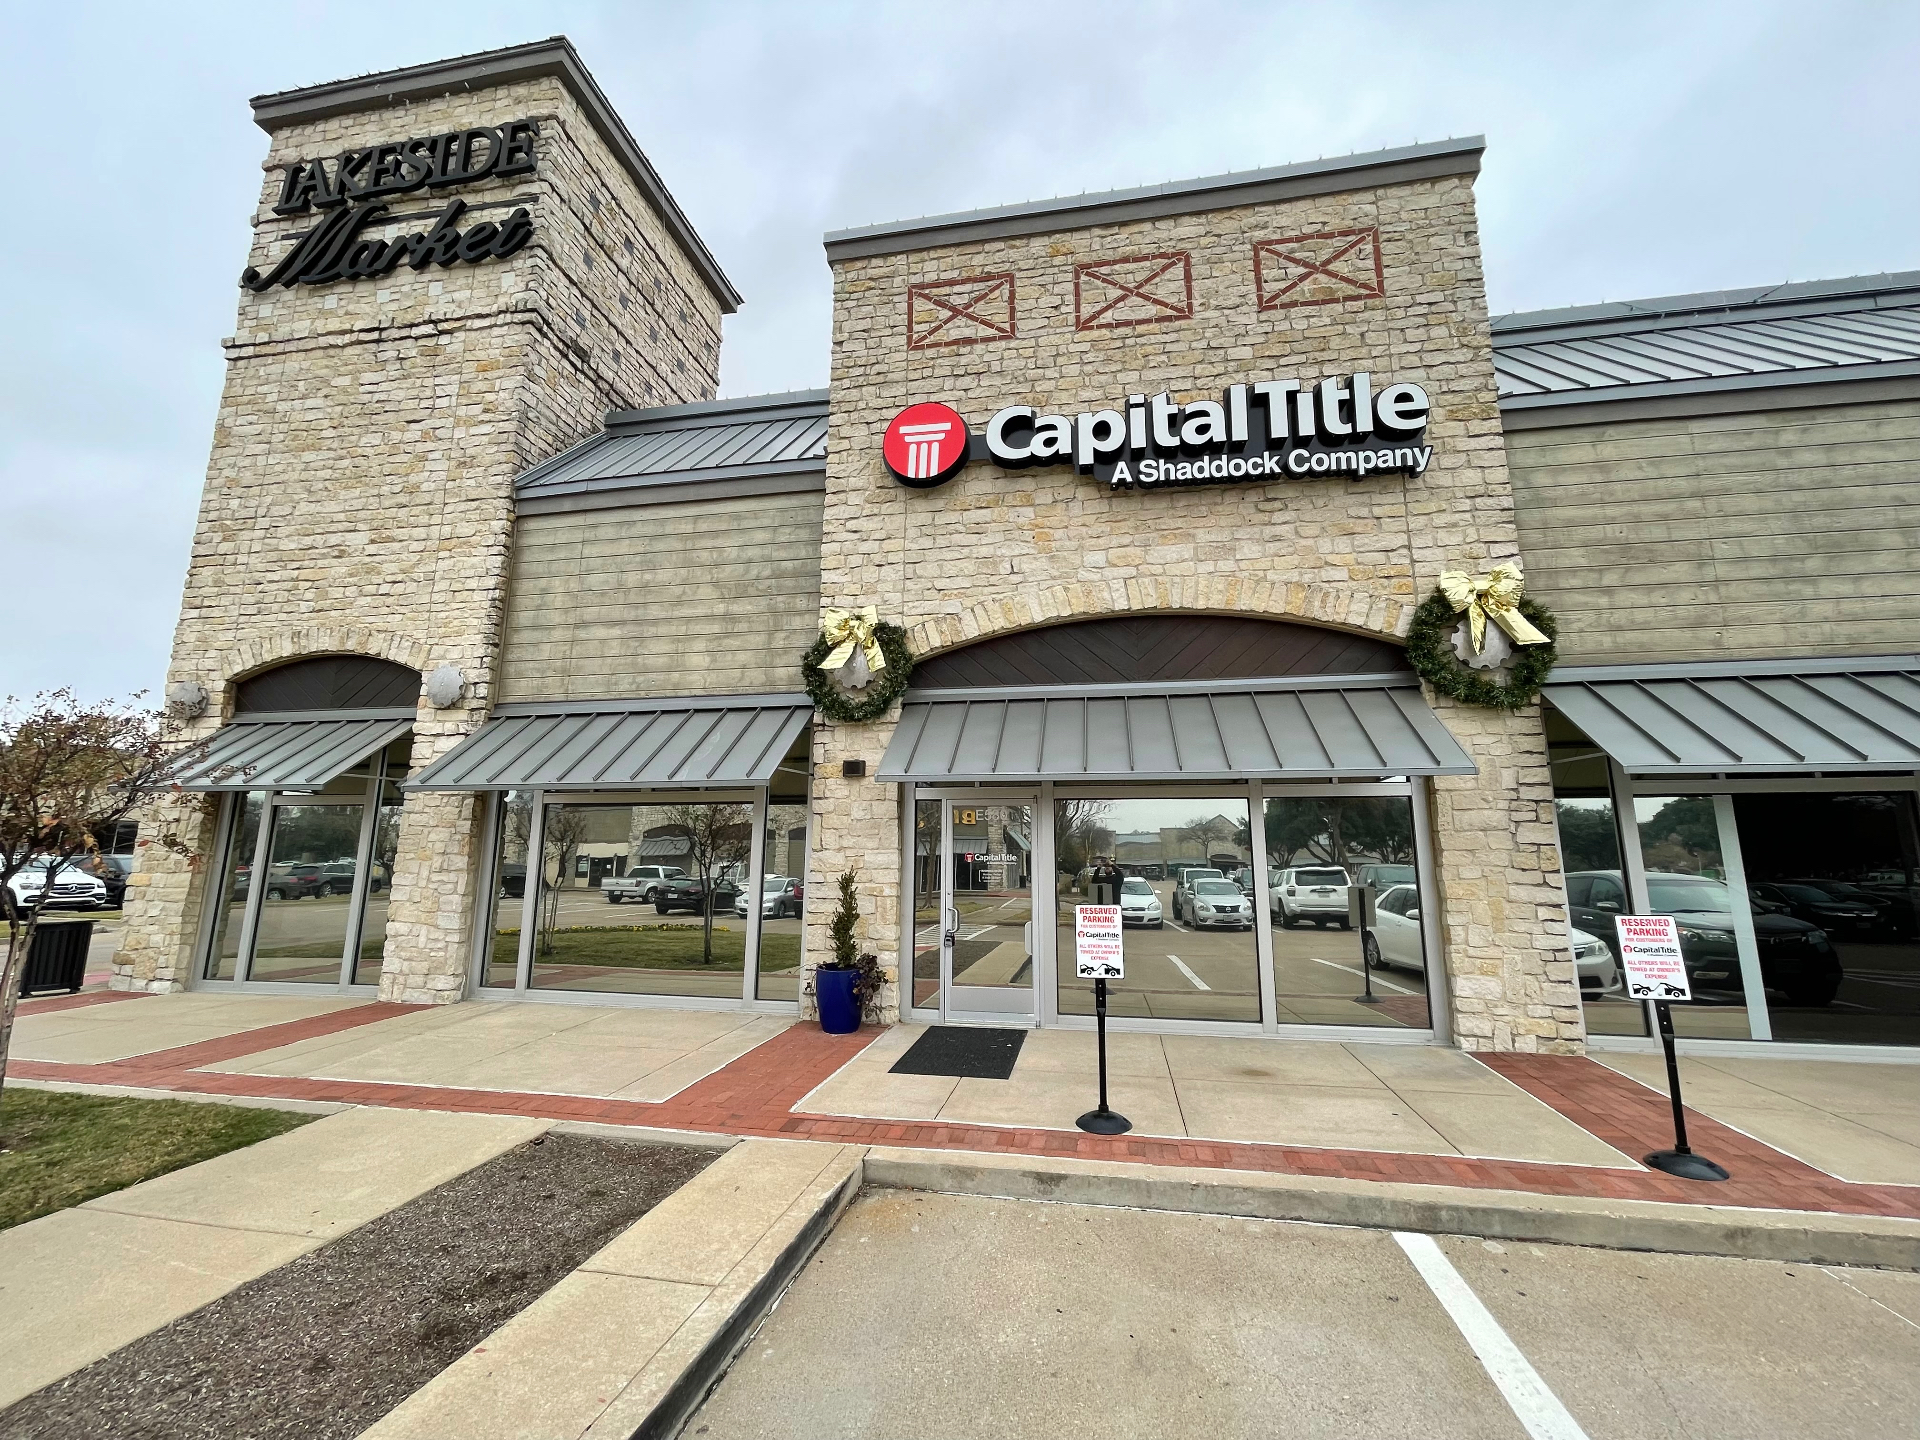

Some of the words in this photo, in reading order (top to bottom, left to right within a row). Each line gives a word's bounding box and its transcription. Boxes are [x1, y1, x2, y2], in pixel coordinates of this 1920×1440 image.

[272, 117, 540, 216] LAKESIDE
[242, 199, 534, 292] Market
[1110, 460, 1134, 484] A
[1138, 451, 1281, 483] Shaddock
[1287, 445, 1433, 475] Company
[1079, 907, 1118, 915] RESERVED
[1082, 915, 1115, 923] PARKING
[1621, 918, 1670, 927] RESERVED
[1626, 928, 1669, 937] PARKING
